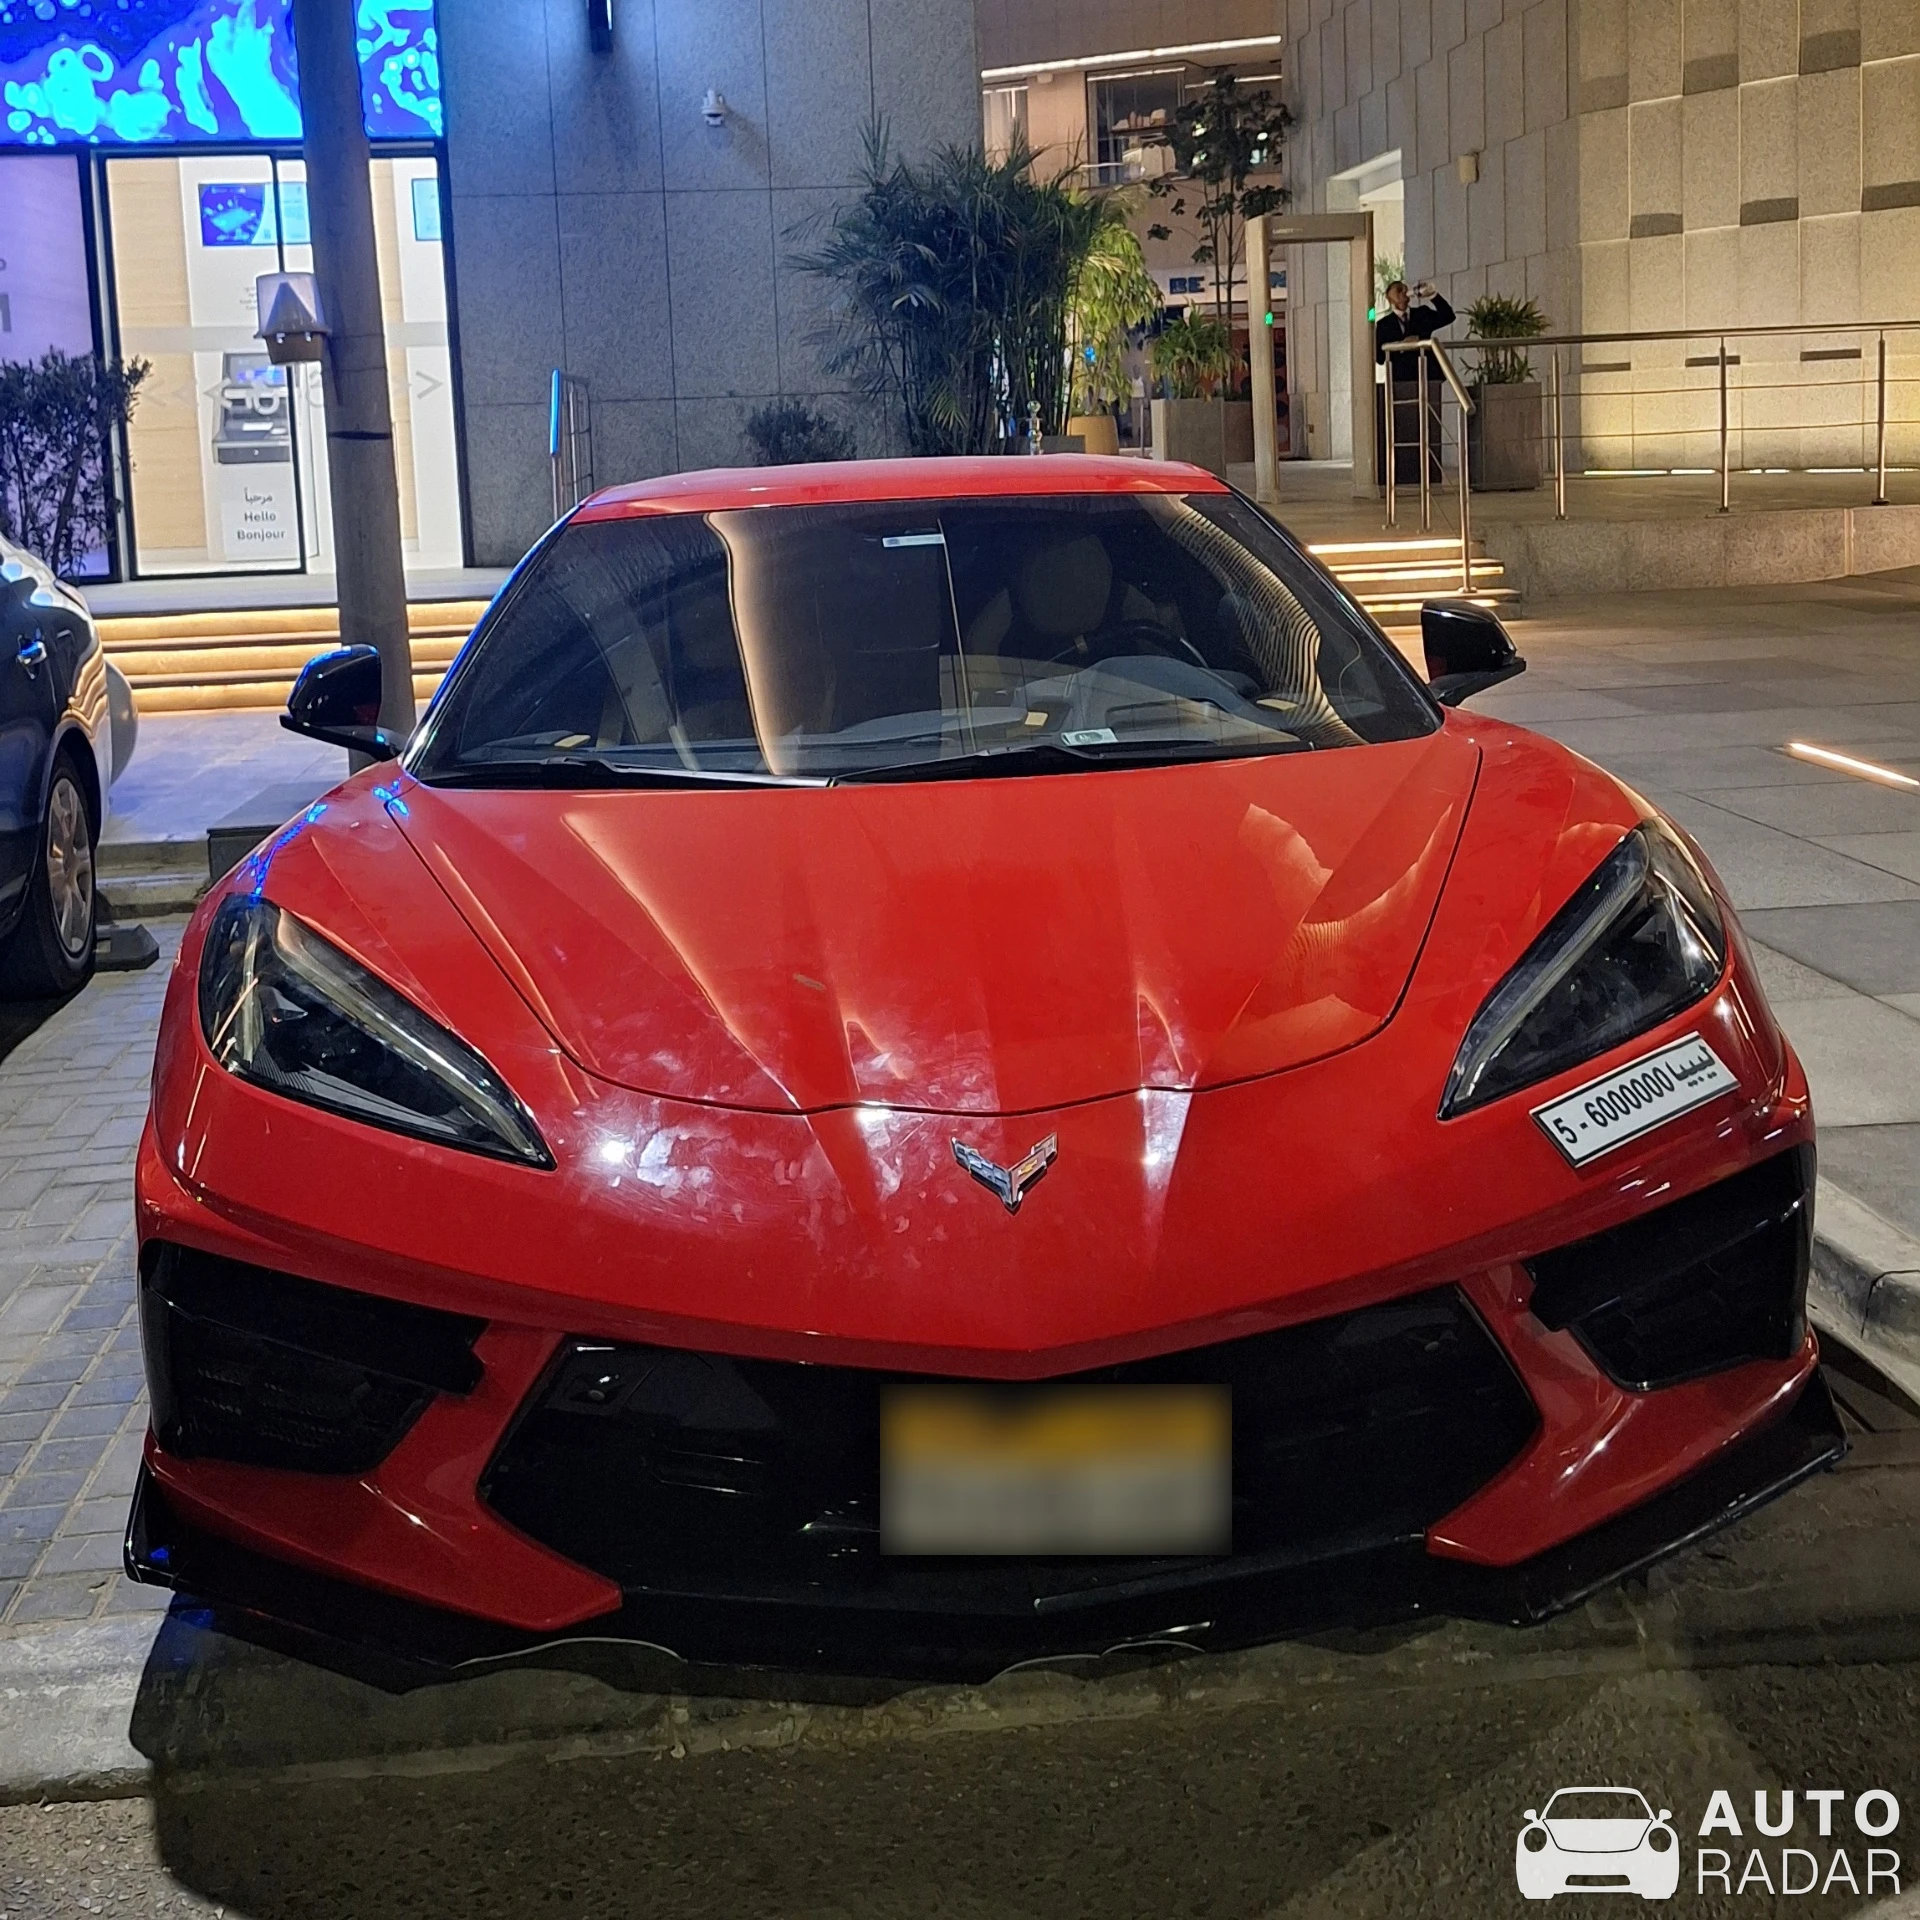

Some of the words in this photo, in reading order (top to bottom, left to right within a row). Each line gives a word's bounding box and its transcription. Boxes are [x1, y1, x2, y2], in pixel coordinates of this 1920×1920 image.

[244, 510, 276, 522] Hello
[237, 529, 286, 542] Bonjour
[1665, 1045, 1718, 1088] ليبيا
